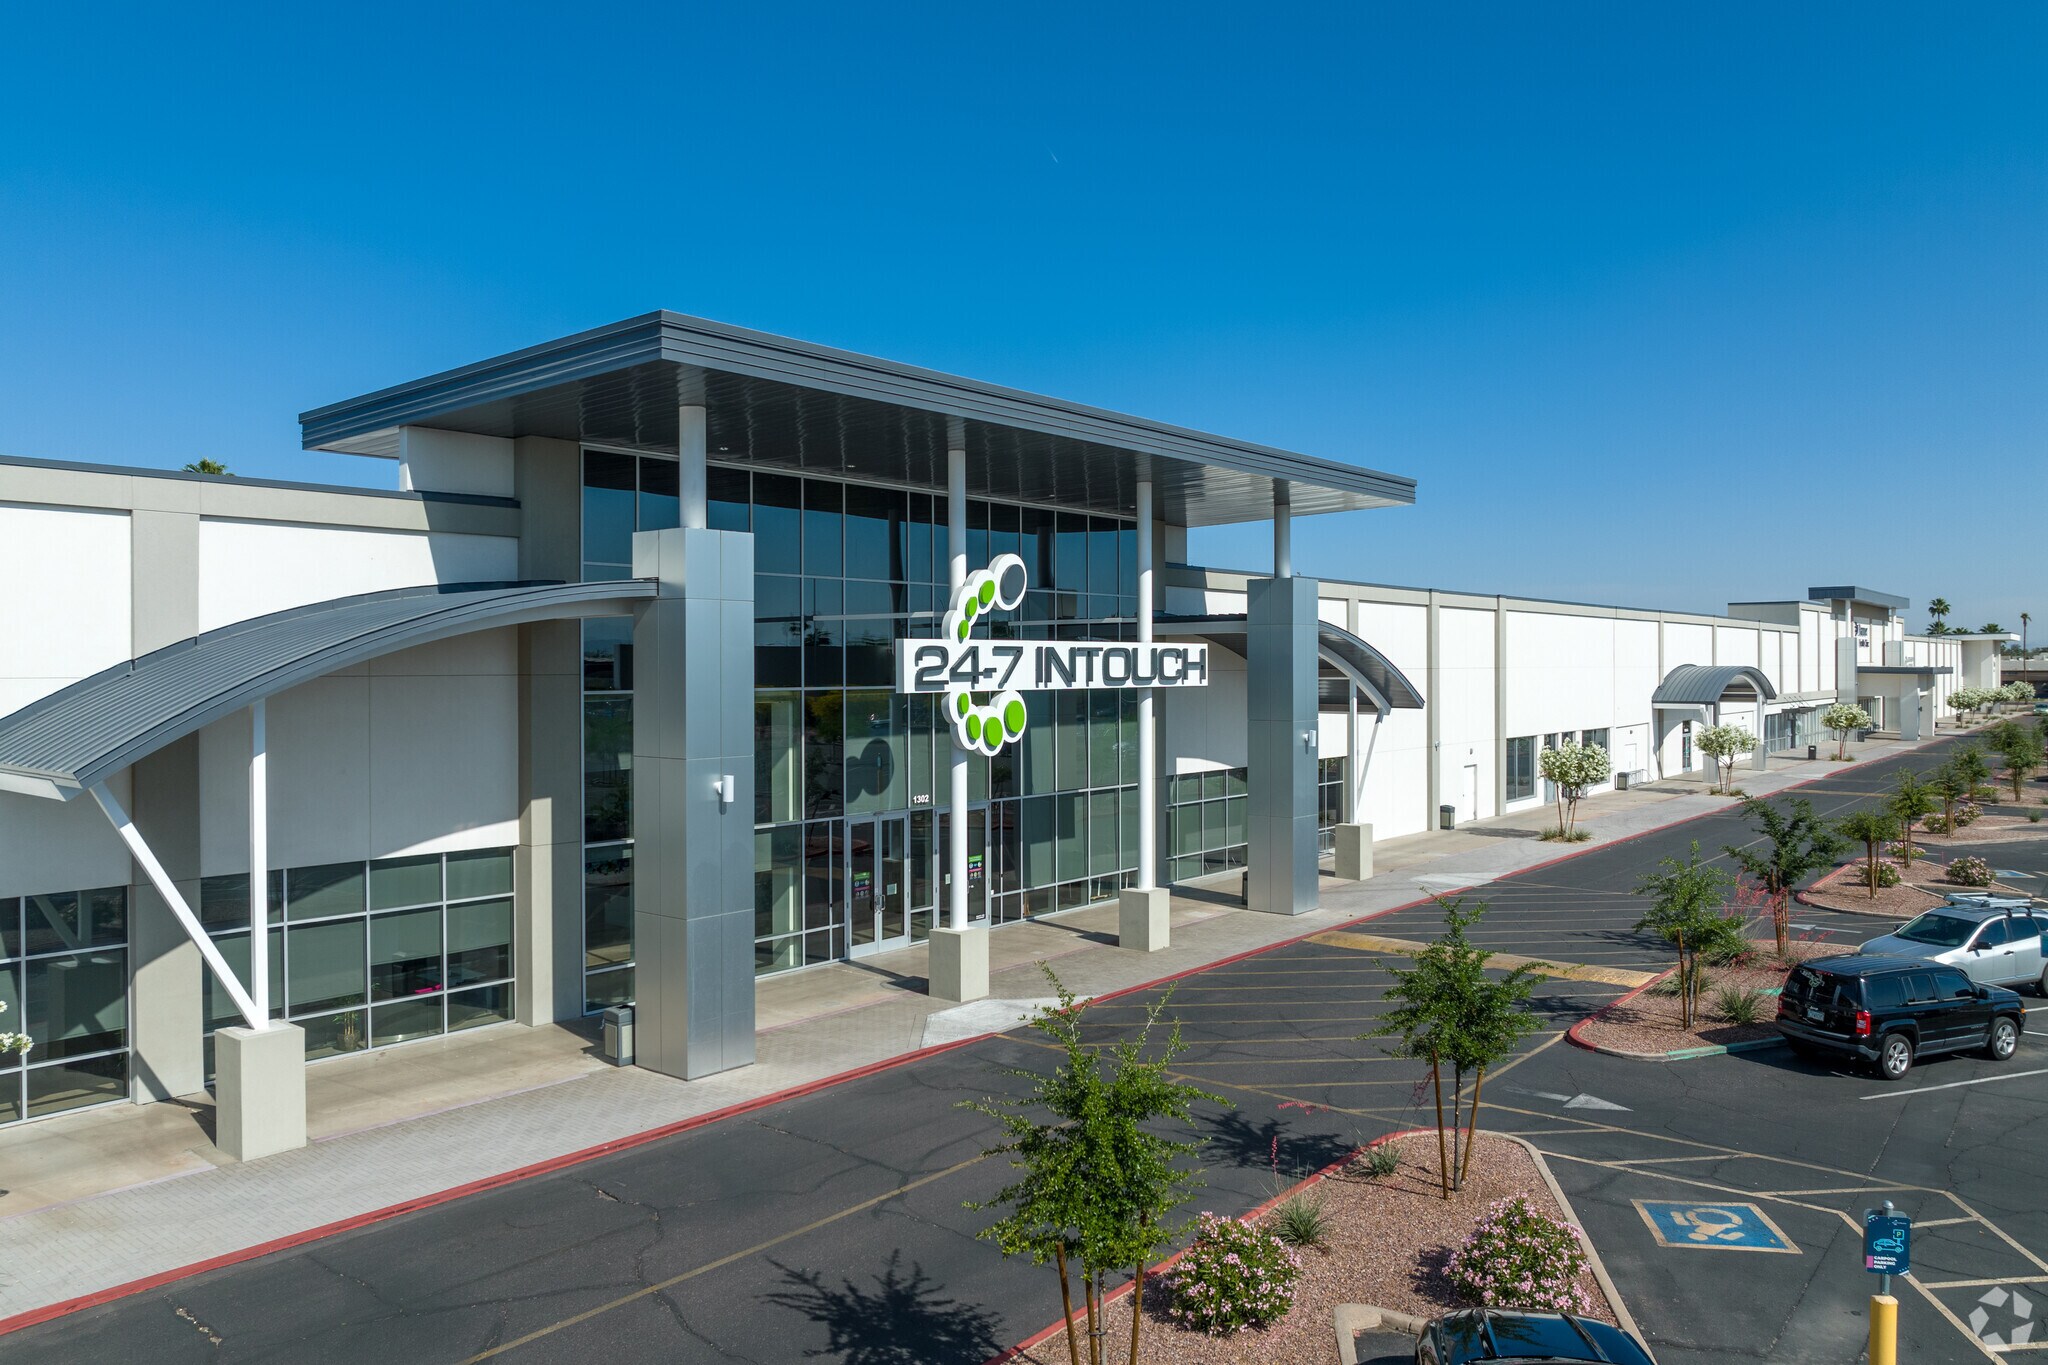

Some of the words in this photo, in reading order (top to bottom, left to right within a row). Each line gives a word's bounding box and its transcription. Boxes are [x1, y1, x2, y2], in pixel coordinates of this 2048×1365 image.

[914, 645, 1023, 690] 24-7
[1035, 646, 1206, 687] INTOUCH
[913, 794, 929, 803] 1302
